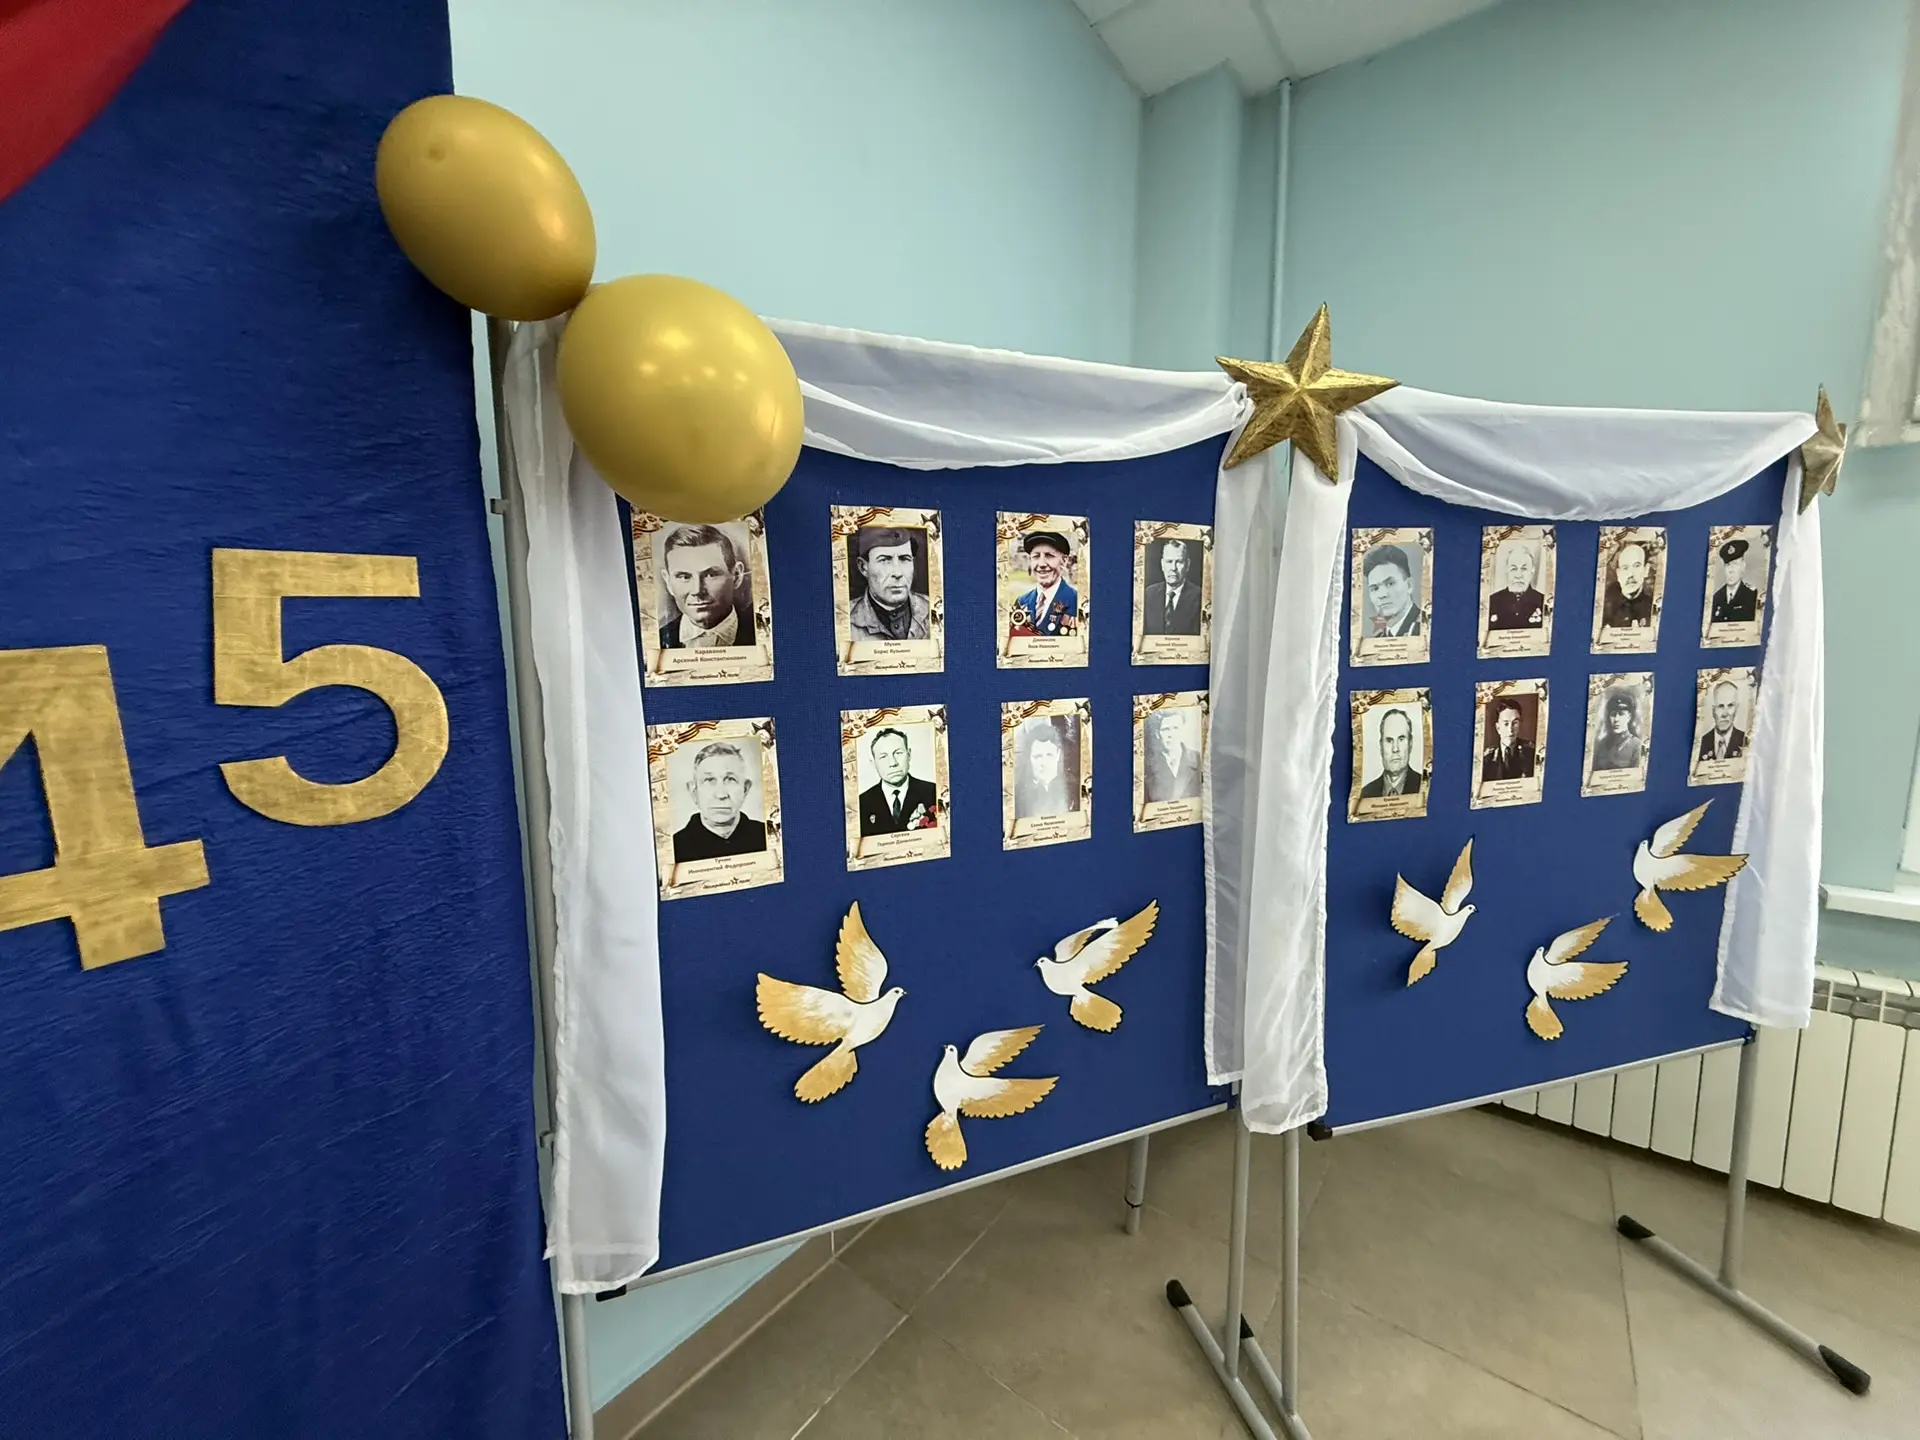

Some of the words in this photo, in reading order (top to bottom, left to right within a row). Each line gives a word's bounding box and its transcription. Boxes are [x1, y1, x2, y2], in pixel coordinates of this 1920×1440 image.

[672, 656, 699, 664] Арсений
[699, 655, 748, 663] Константинович
[688, 864, 724, 874] Иннокентий
[724, 860, 756, 869] Федорович
